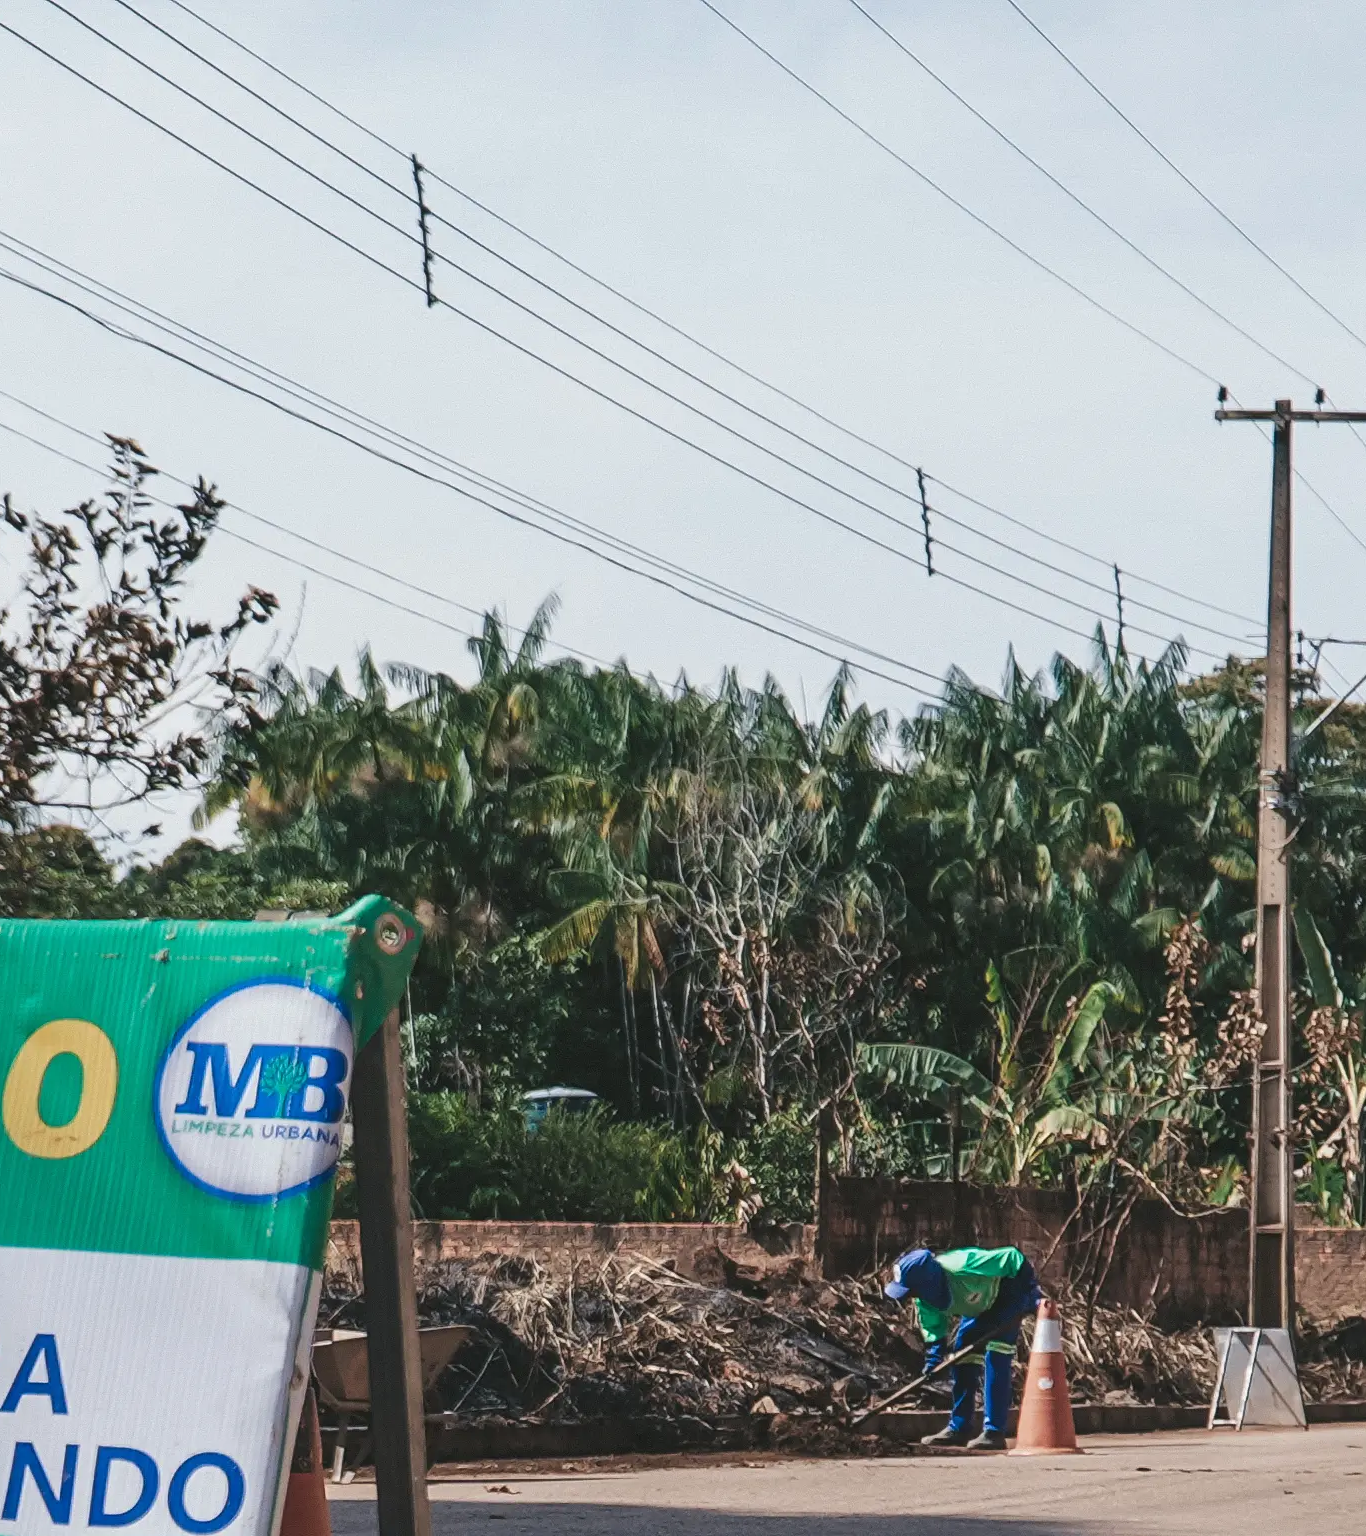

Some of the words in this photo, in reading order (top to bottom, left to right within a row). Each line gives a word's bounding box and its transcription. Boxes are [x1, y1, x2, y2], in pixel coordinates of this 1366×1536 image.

[174, 1041, 348, 1124] MB
[171, 1119, 255, 1139] LIMPEZA
[261, 1123, 340, 1147] URBANA
